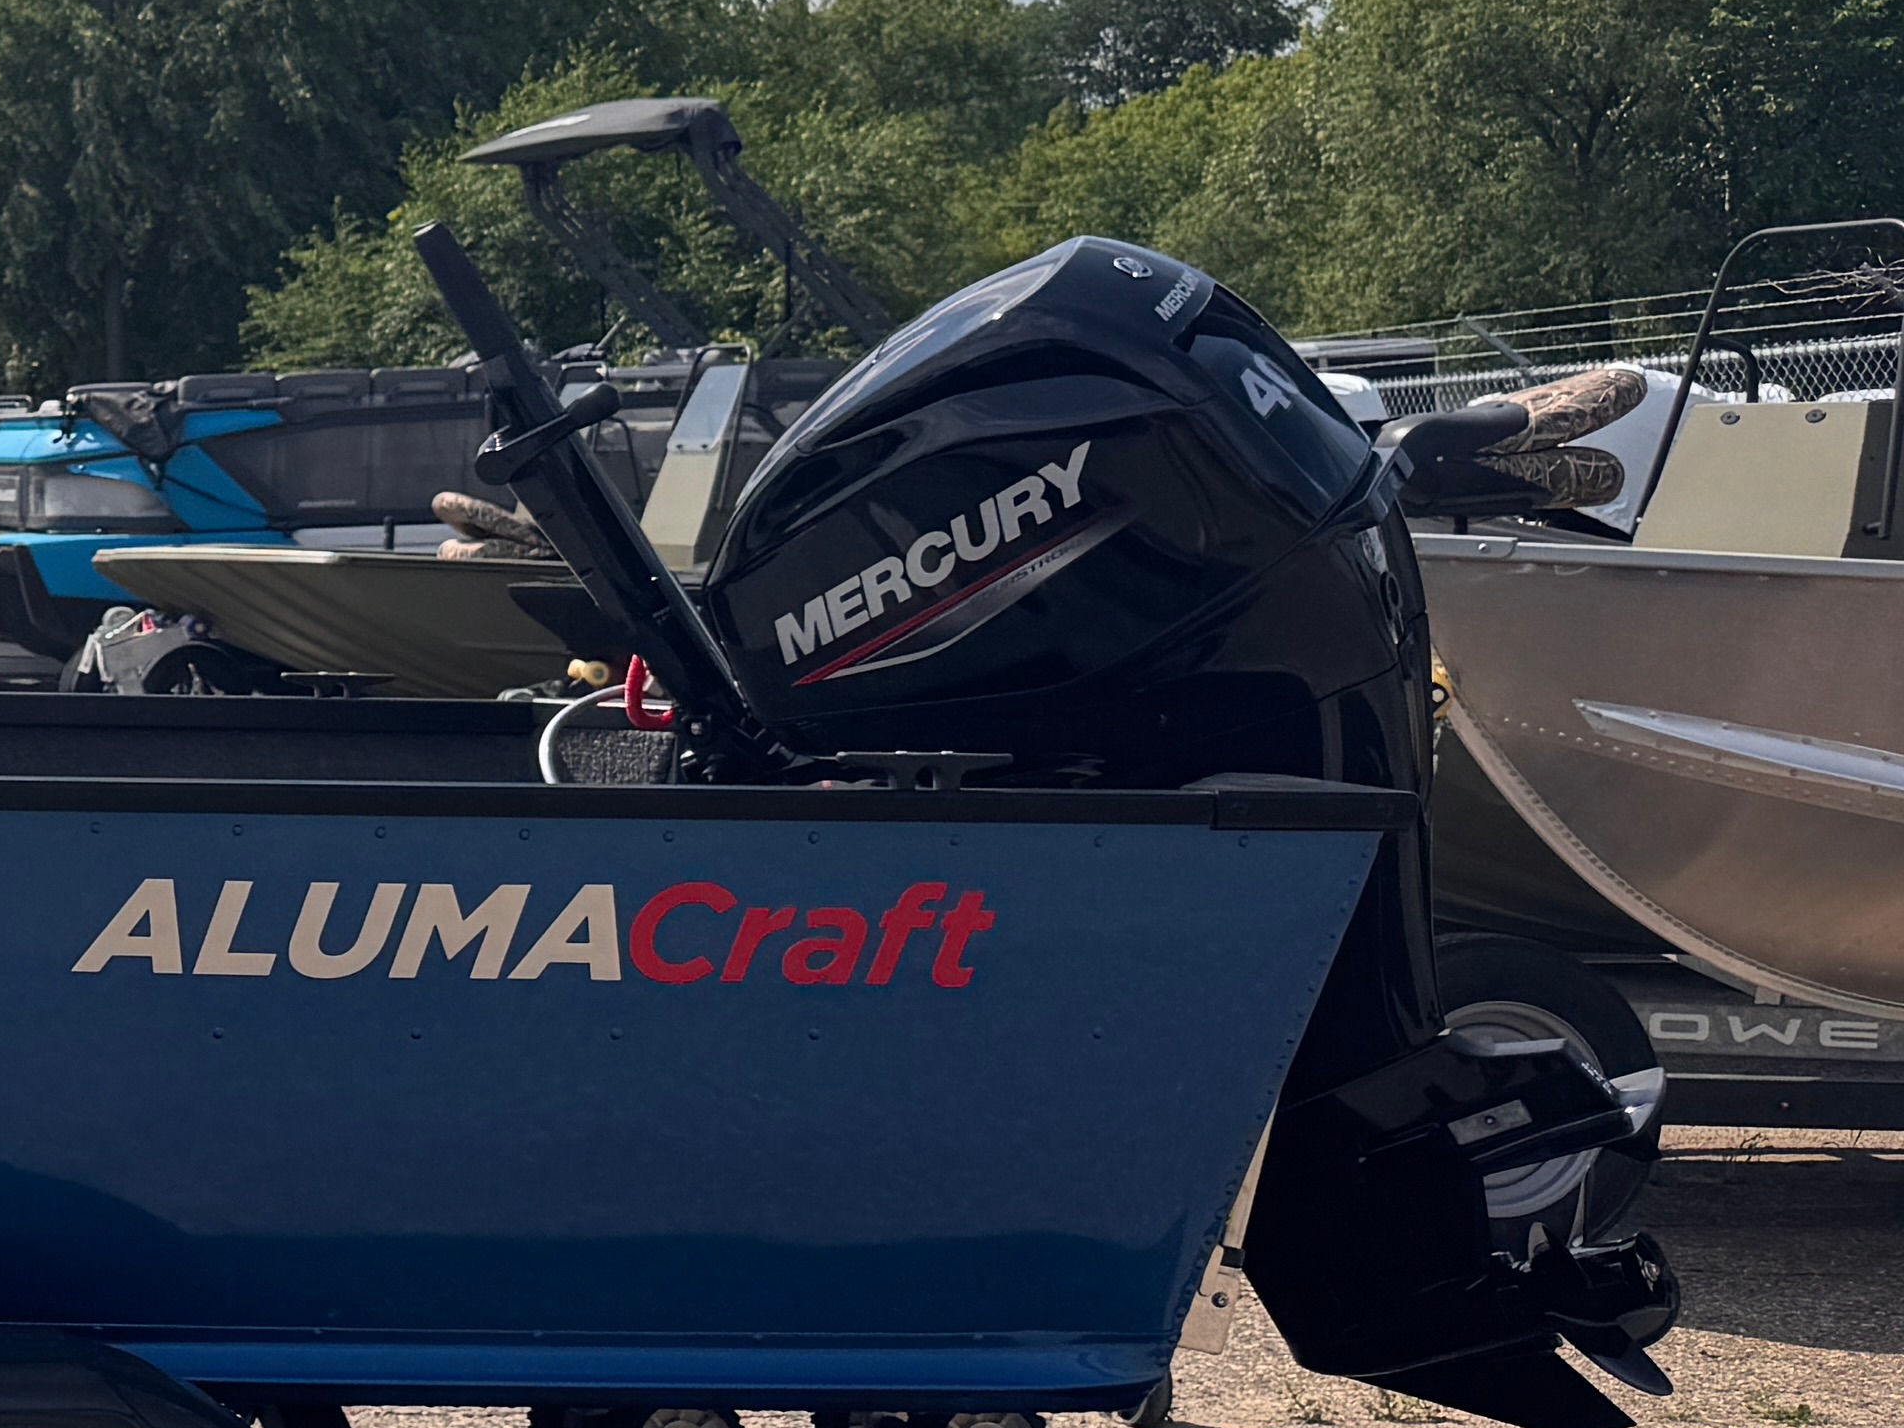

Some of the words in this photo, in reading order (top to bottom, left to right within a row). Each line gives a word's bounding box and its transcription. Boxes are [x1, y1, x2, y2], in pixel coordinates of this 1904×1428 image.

[1240, 353, 1301, 418] 40
[774, 440, 1092, 666] MERCURY
[71, 878, 998, 988] ALUMACraft
[1649, 1012, 1880, 1049] OWE
